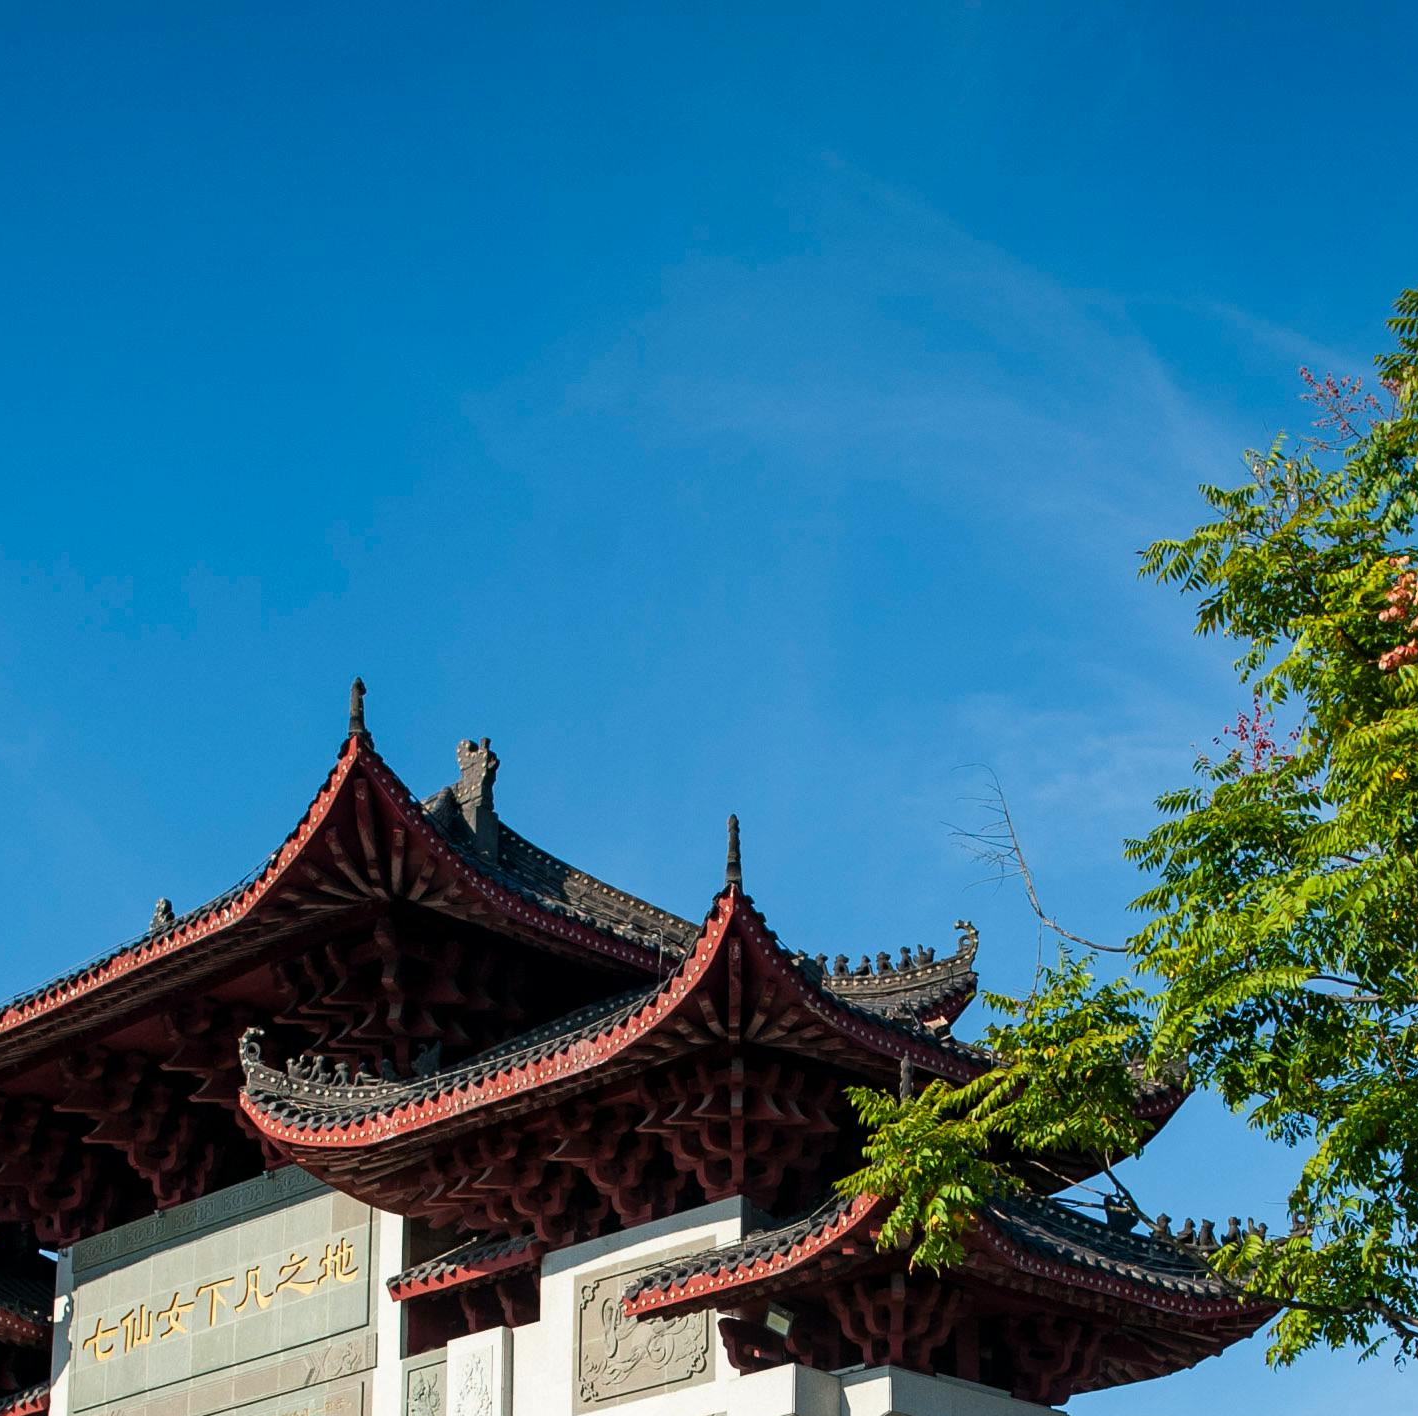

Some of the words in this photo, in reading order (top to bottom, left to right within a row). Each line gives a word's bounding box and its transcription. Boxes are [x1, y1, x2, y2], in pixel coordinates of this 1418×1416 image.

[82, 1237, 359, 1362] 七仙女下凡之地
